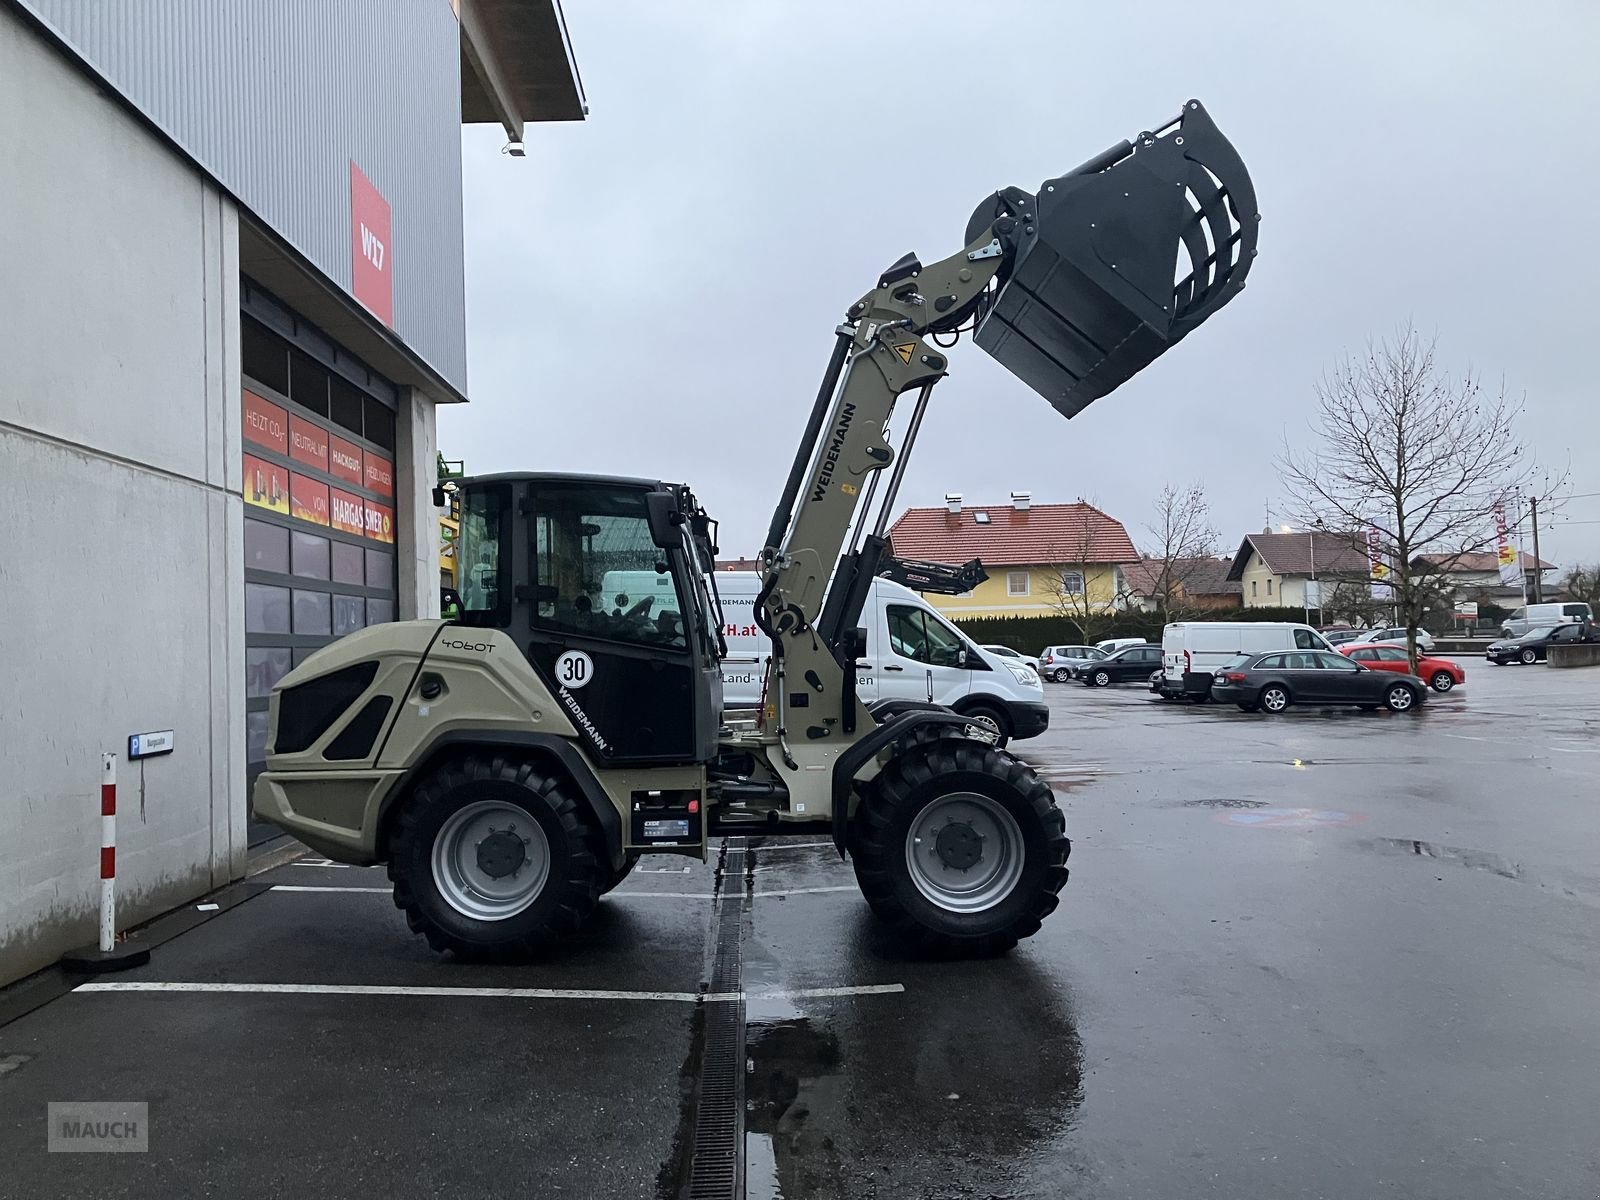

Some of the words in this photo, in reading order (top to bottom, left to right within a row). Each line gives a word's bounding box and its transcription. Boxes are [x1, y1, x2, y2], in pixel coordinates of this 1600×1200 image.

[360, 222, 384, 272] W17
[246, 409, 268, 431] HEIZT
[811, 403, 857, 502] WEIDEMANN
[313, 496, 326, 513] VON
[722, 624, 757, 637] H.at
[441, 639, 496, 653] 4060T
[563, 657, 585, 681] 30
[558, 686, 607, 750] WEIDEMANN
[132, 738, 139, 753] P
